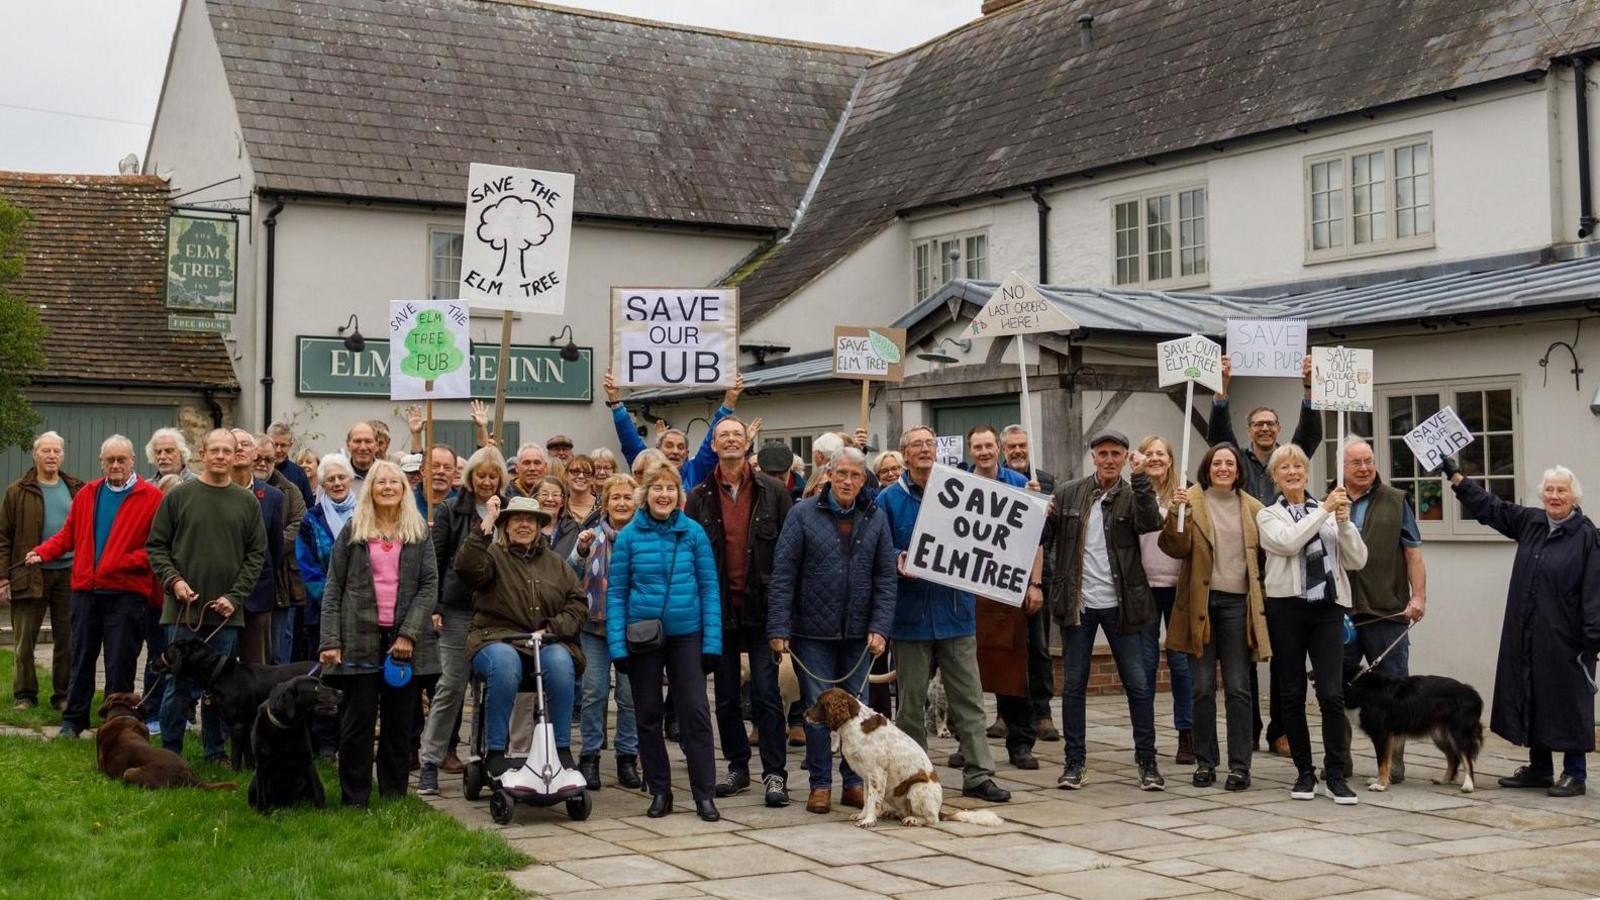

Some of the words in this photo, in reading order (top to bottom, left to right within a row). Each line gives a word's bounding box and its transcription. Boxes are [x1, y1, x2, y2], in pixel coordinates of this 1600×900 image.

[471, 176, 513, 203] SAVE
[531, 179, 562, 208] THE
[186, 243, 220, 260] ELM
[179, 261, 225, 279] TREE
[464, 270, 503, 295] ELM
[520, 271, 560, 297] TREE
[1002, 285, 1025, 300] NO
[390, 303, 417, 331] SAVE
[448, 304, 468, 327] THE
[626, 296, 720, 322] SAVE
[988, 303, 1009, 317] LAST
[1014, 299, 1048, 314] ORDERS
[419, 313, 442, 324] ELM
[412, 331, 444, 345] TREE
[649, 325, 699, 344] OUR
[839, 337, 868, 351] SAVE
[1238, 324, 1301, 347] SAVE
[1164, 341, 1191, 359] SAVE
[1196, 340, 1219, 358] OUR
[1326, 348, 1356, 362] SAVE
[416, 352, 449, 371] PUB
[509, 356, 565, 383] INN
[628, 350, 720, 383] PUB
[837, 355, 861, 370] ELM
[866, 356, 887, 370] TREE
[1230, 350, 1267, 369] OUR
[1274, 351, 1303, 372] PUB
[1331, 360, 1355, 372] OUR
[1324, 379, 1357, 399] PUB
[1412, 411, 1448, 443] SAVE
[1427, 427, 1448, 445] OUR
[935, 436, 957, 447] VE
[1425, 431, 1469, 467] PUB
[937, 477, 1029, 529] SAVE
[953, 516, 1011, 551] OUR
